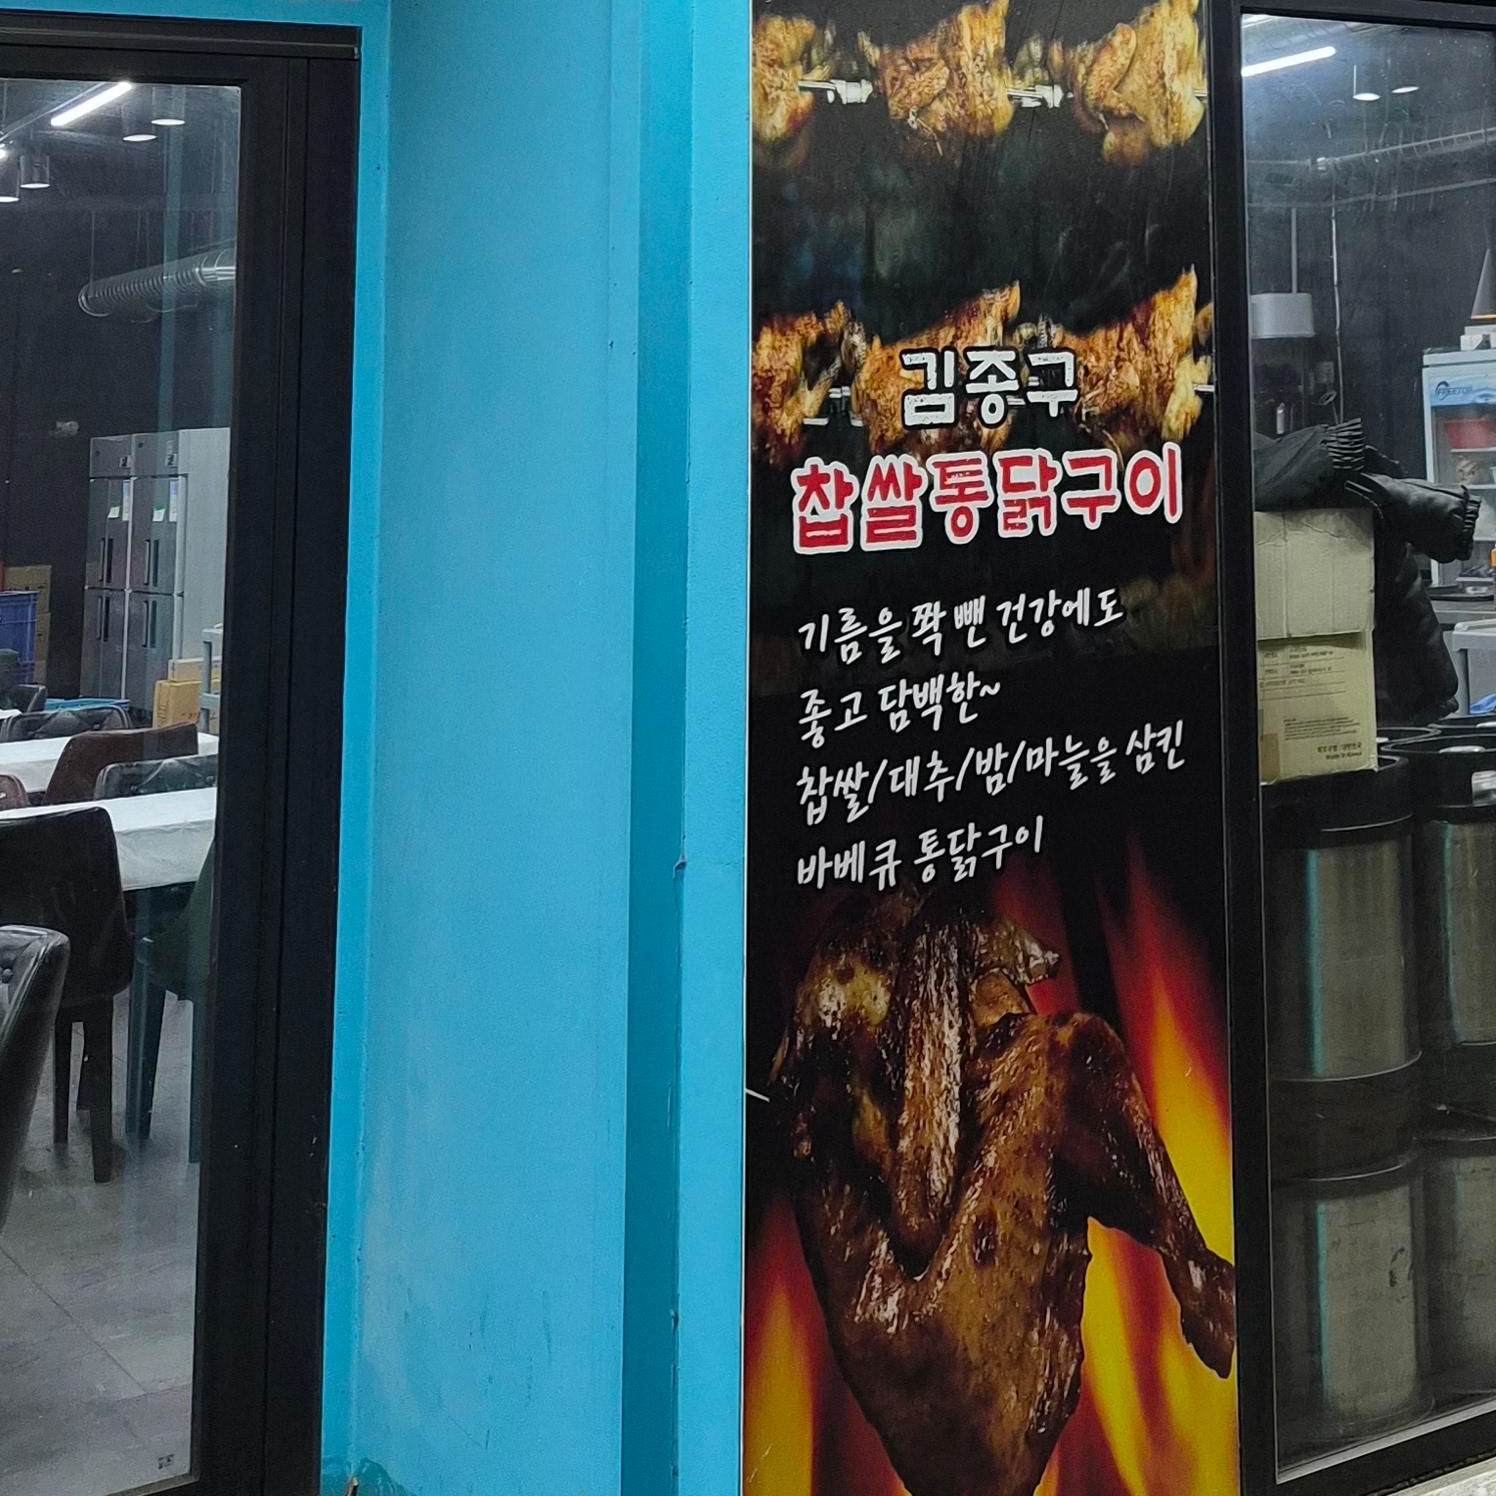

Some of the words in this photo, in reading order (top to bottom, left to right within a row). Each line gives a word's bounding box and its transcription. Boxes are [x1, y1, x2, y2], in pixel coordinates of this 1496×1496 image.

[902, 350, 1079, 426] 김종구
[794, 444, 1182, 552] 찹쌀통닭구이
[798, 605, 902, 665] 기름을
[953, 593, 987, 648] 뺀
[996, 587, 1124, 646] 건강에도
[798, 687, 869, 750] 좋고
[1126, 719, 1186, 776] 삼킨
[797, 837, 903, 892] 바베큐
[912, 814, 1046, 885] 통닭구이
